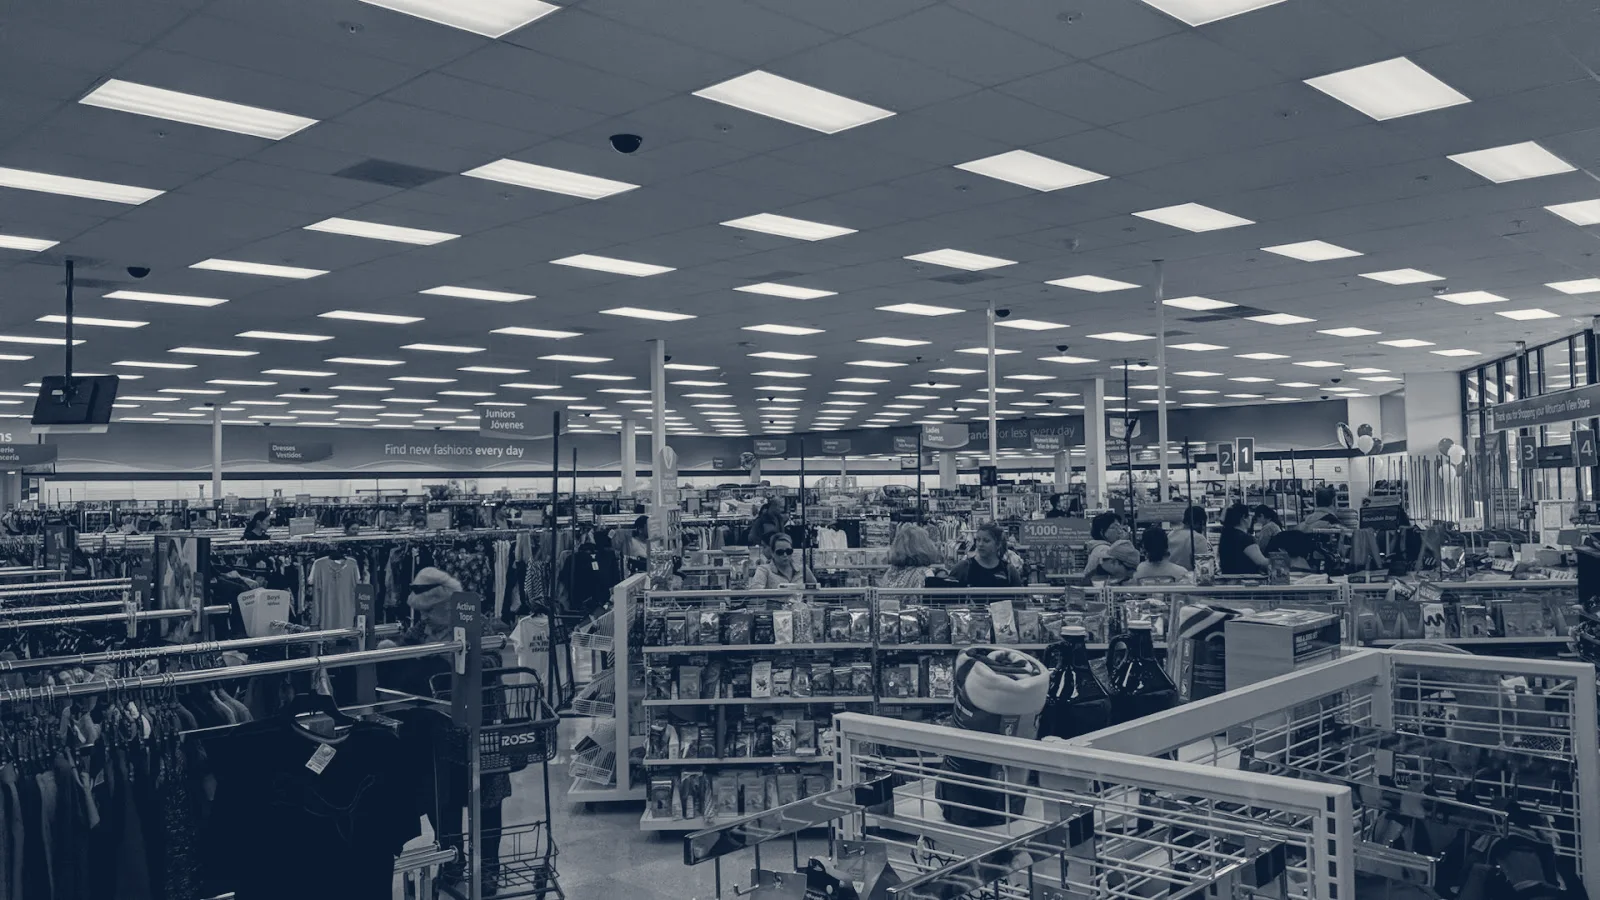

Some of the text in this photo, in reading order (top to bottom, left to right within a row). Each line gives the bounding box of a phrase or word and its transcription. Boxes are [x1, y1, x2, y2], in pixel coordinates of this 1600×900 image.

[1545, 402, 1566, 414] Mountain
[1566, 399, 1577, 411] View
[1577, 398, 1590, 409] Store
[485, 409, 516, 419] Juniors
[490, 420, 525, 430] Jóvenes
[1011, 427, 1027, 438] less
[1057, 424, 1075, 438] day
[385, 443, 525, 458] Find new fashions every day
[1241, 446, 1249, 464] 1
[1524, 444, 1535, 460] 3
[1581, 439, 1593, 457] 4
[1221, 451, 1231, 467] 2
[456, 602, 476, 611] Active
[459, 612, 473, 623] Tops
[502, 732, 535, 746] ROSS
